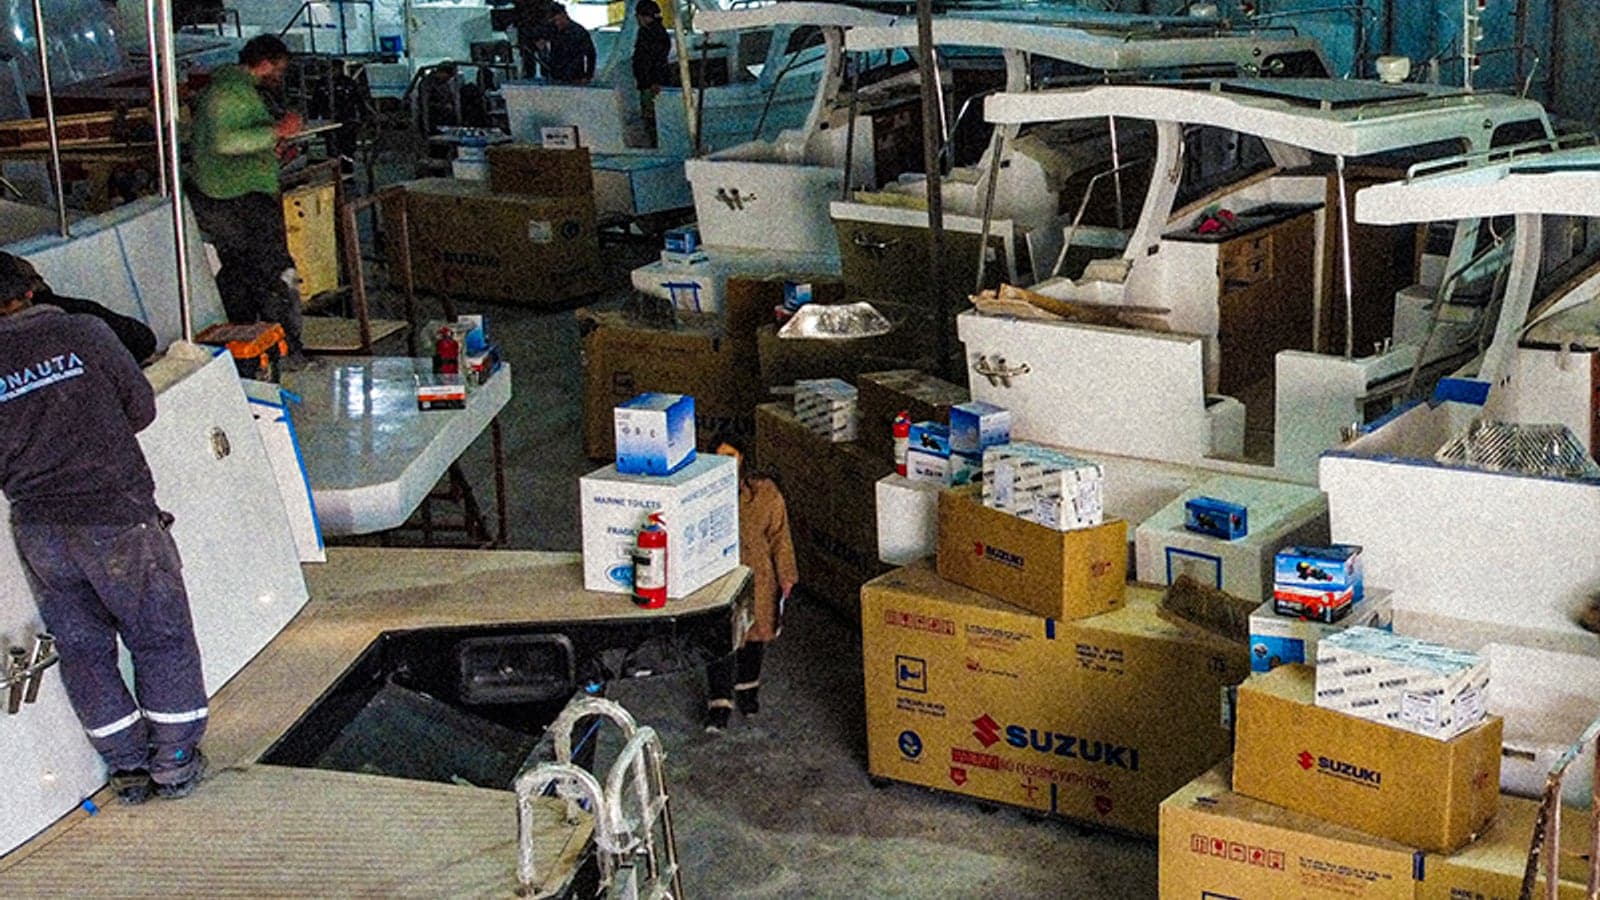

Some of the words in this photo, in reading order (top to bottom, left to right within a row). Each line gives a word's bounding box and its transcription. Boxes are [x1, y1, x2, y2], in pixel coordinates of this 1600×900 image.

[593, 496, 625, 507] MARINE
[627, 499, 662, 509] TOILETS
[1006, 724, 1139, 771] SUZUKI
[1318, 756, 1381, 784] SUZUKI
